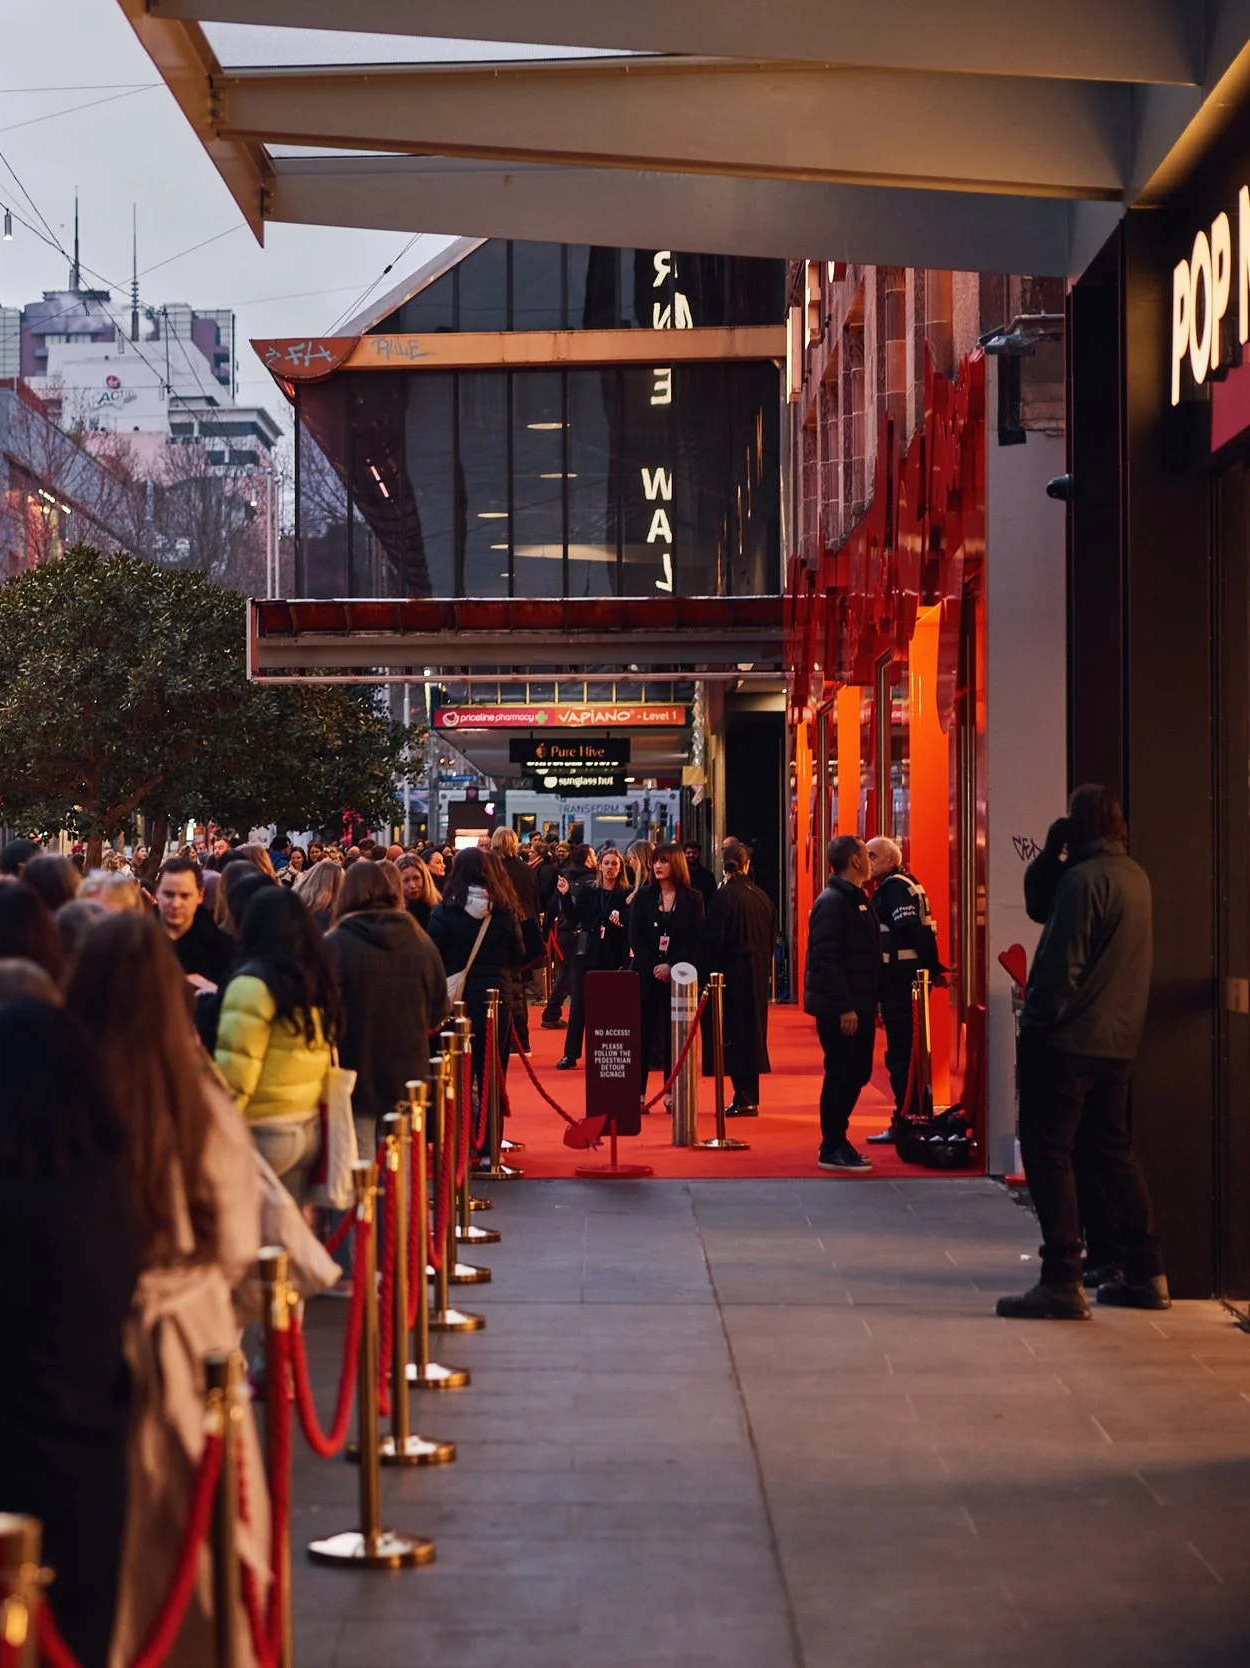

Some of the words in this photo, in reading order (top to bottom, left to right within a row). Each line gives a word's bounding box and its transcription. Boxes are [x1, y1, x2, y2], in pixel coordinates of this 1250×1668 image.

[1171, 210, 1232, 407] POP
[459, 712, 495, 723] priceline
[494, 712, 535, 723] pharmacy
[557, 709, 631, 724] VAPIANO
[642, 711, 669, 720] Level
[672, 710, 677, 720] 1
[550, 746, 577, 757] Pure
[579, 745, 606, 757] Hive
[558, 776, 597, 788] sunglass
[597, 776, 614, 785] hut
[558, 804, 619, 814] TRANSFORM
